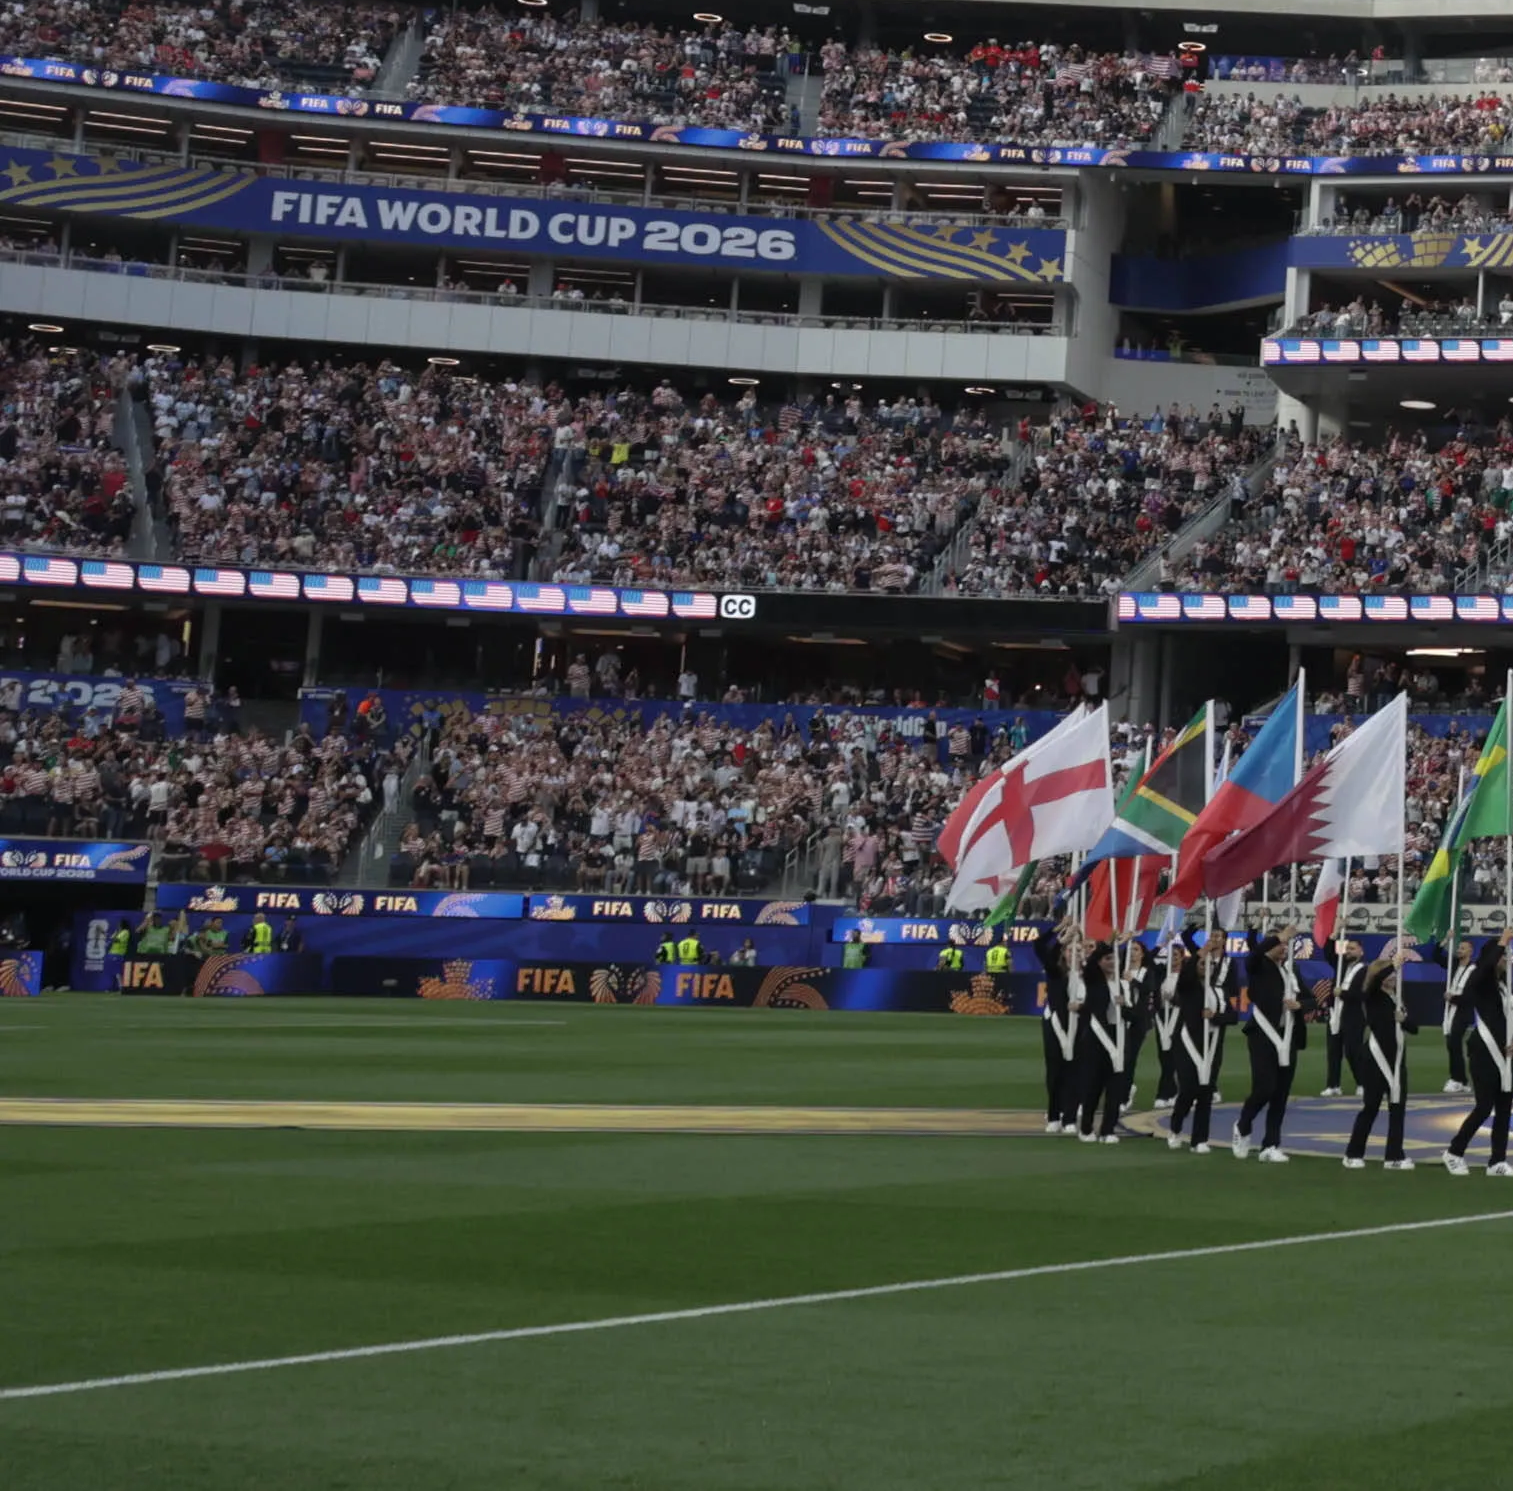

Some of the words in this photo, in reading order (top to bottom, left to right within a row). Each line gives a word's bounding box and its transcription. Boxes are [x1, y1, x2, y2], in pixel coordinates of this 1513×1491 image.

[44, 65, 75, 78] FIFA
[125, 75, 153, 88] FIFA
[301, 97, 328, 109] FIFA
[375, 103, 402, 115] FIFA
[544, 119, 570, 129] FIFA
[615, 125, 642, 135] FIFA
[778, 139, 804, 149] FIFA
[846, 143, 871, 153] FIFA
[1000, 149, 1025, 158] FIFA
[1067, 151, 1092, 161] FIFA
[1220, 157, 1244, 167] FIFA
[1286, 160, 1311, 170] FIFA
[1432, 158, 1456, 168] FIFA
[271, 191, 368, 228] FIFA
[377, 199, 540, 239] WORLD
[548, 213, 636, 247] CUP
[643, 221, 795, 260] 2026
[724, 598, 753, 616] CC
[27, 679, 154, 707] 202
[54, 854, 91, 868] FIFA
[257, 893, 300, 908] FIFA
[375, 896, 417, 912] FIFA
[593, 901, 632, 916] FIFA
[702, 904, 741, 919] FIFA
[901, 924, 938, 939] FIFA
[1226, 938, 1250, 953] IFA
[123, 962, 164, 987] IFA
[518, 968, 575, 994] FIFA
[675, 972, 734, 998] FIFA
